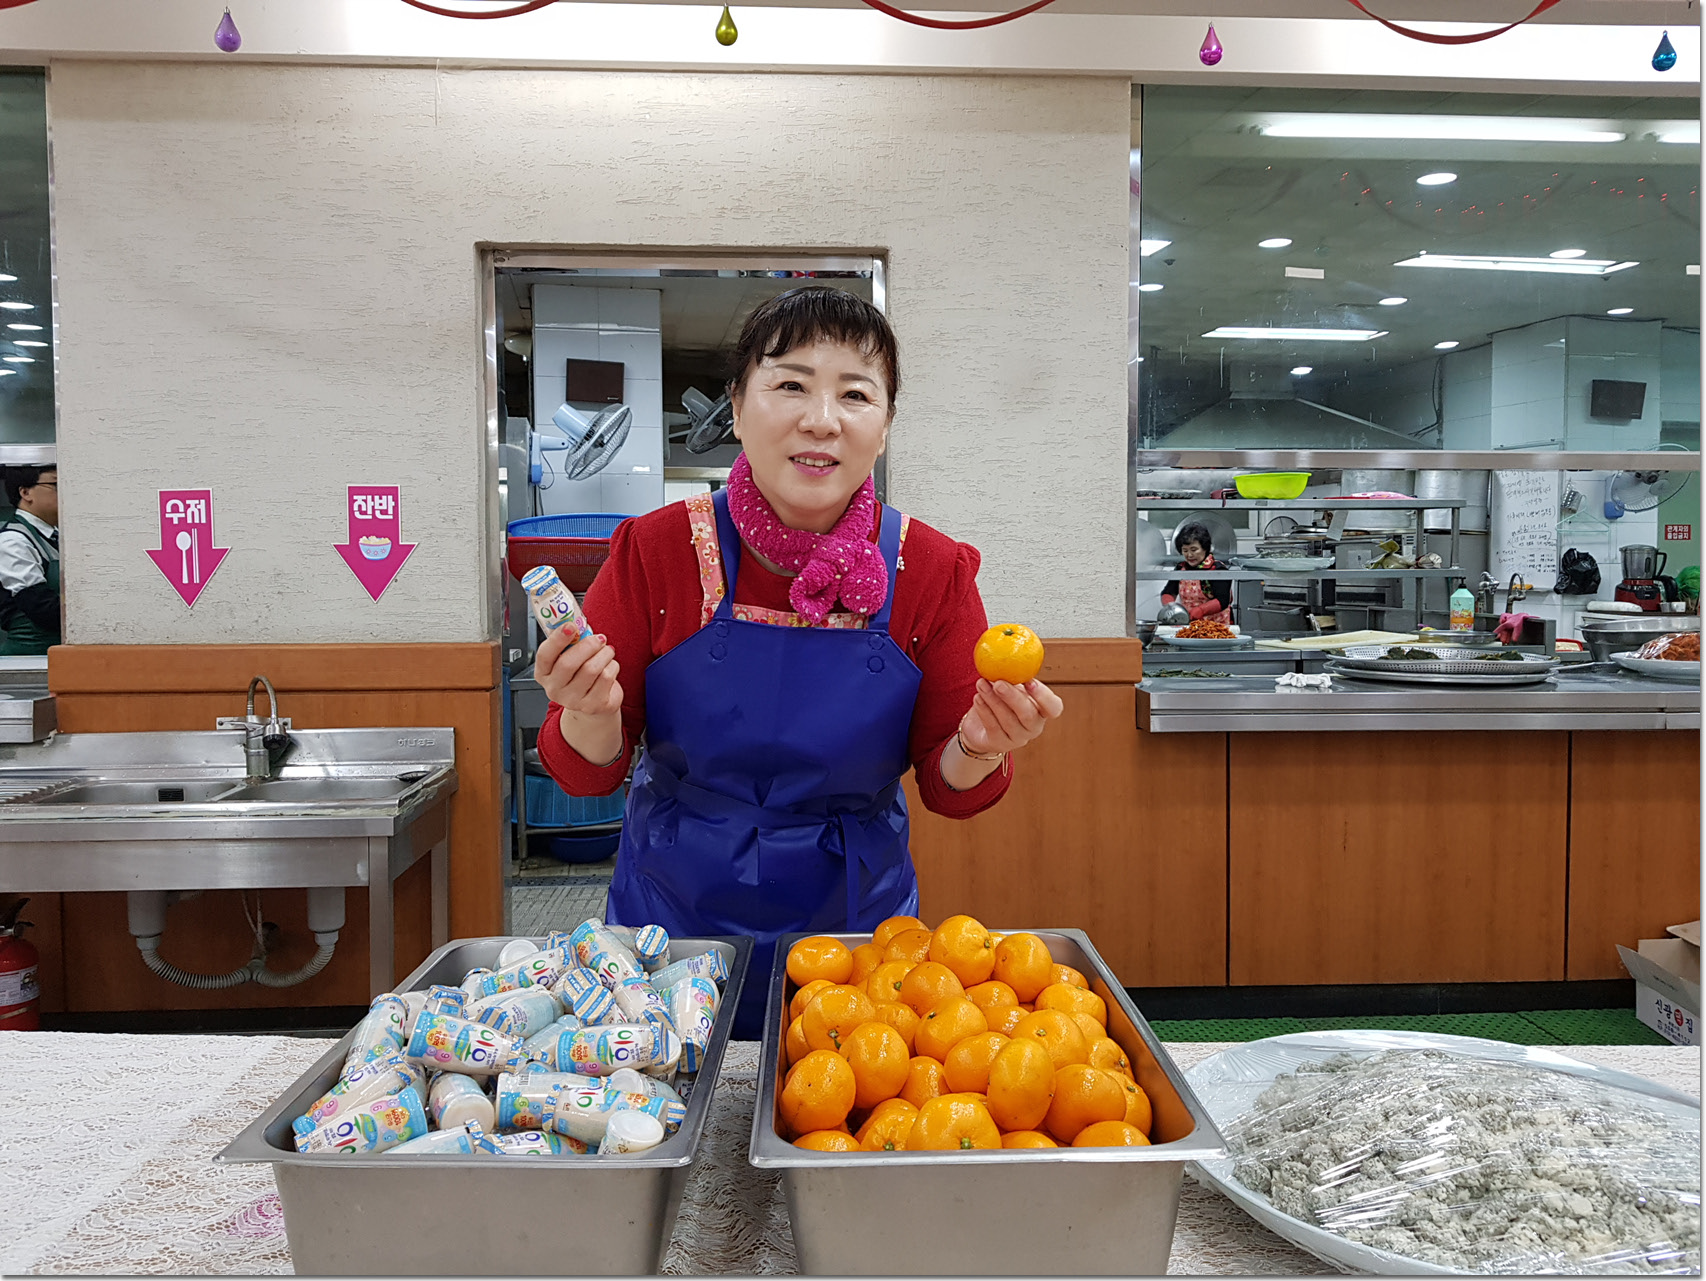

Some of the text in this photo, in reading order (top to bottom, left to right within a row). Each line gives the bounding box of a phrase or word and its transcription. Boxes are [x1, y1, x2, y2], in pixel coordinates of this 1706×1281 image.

[165, 499, 206, 524] 수저
[353, 494, 395, 519] 잔반
[1667, 532, 1689, 540] 출입금지
[609, 1029, 635, 1065] 이오
